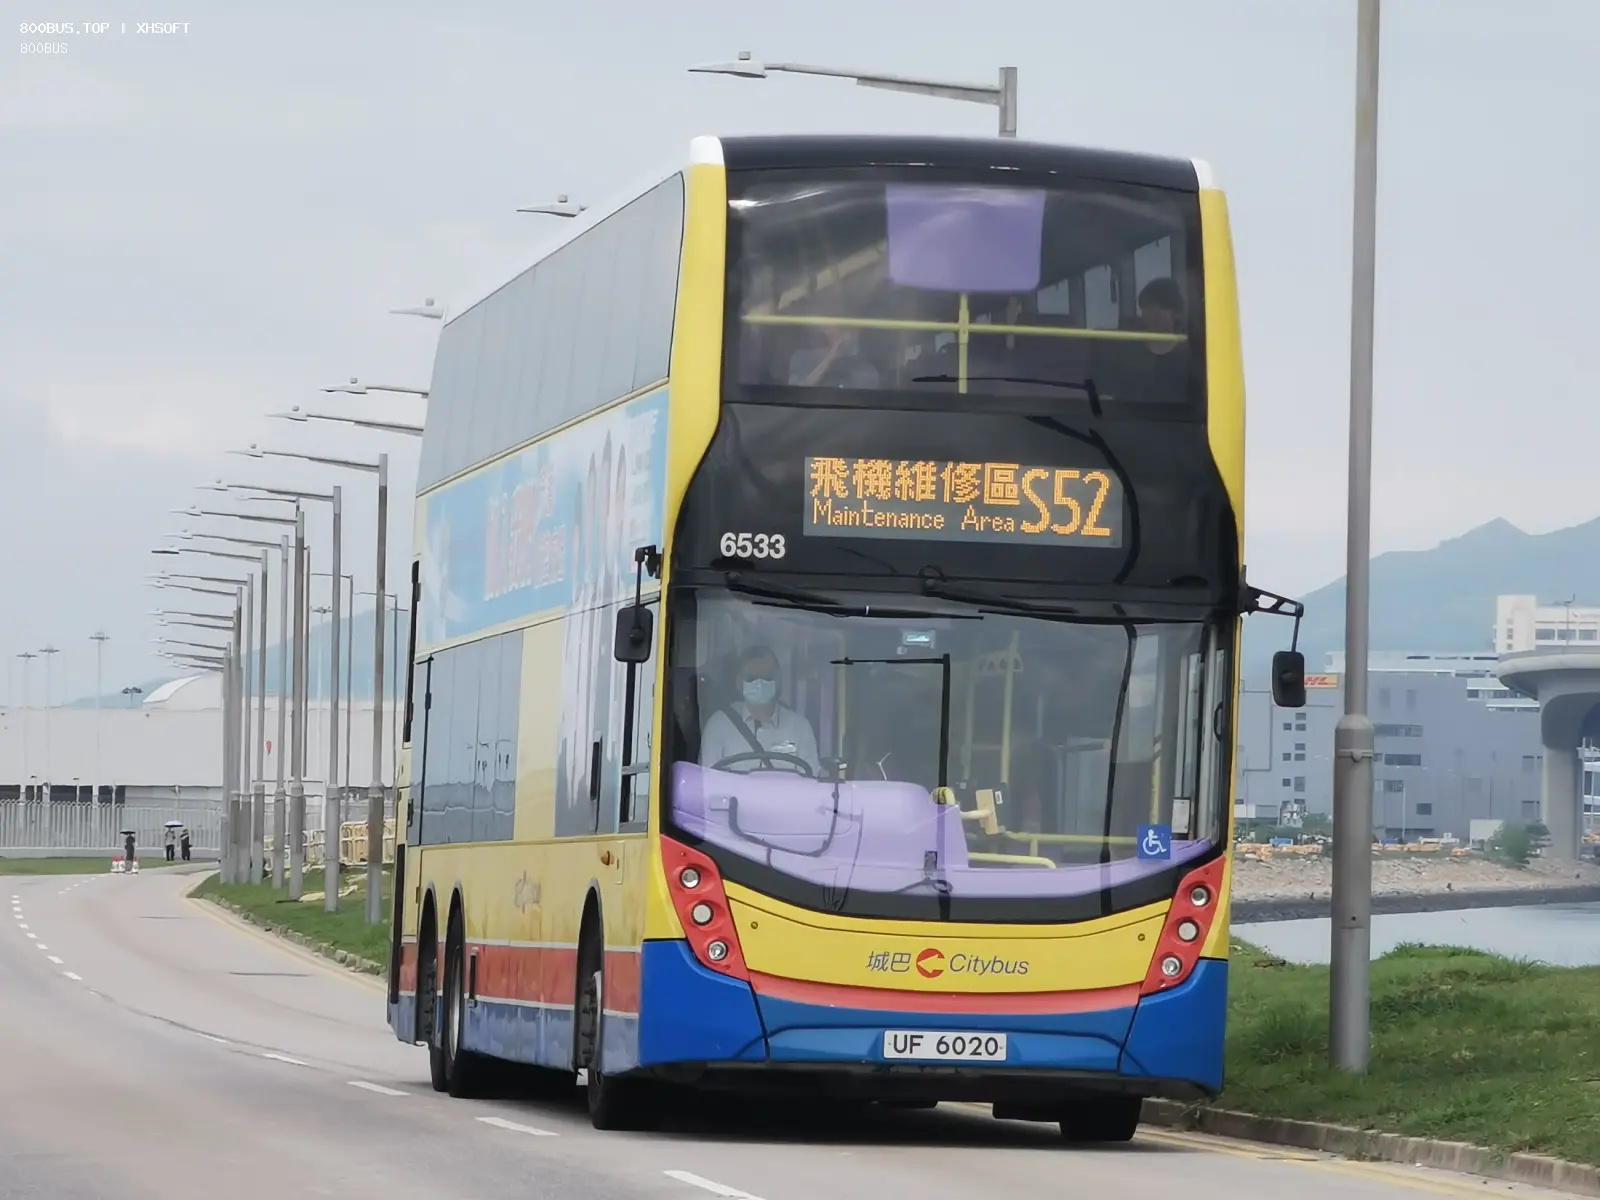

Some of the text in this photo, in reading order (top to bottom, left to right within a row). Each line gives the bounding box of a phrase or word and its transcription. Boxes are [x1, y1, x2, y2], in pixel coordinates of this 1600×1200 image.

[810, 456, 1020, 505] 飛機維修區
[812, 498, 1015, 533] Maintenance Area
[1020, 468, 1111, 536] S52
[719, 532, 786, 560] 6533
[866, 951, 911, 973] 城巴
[949, 953, 1029, 976] Citybus
[893, 1034, 999, 1056] UF 6020
